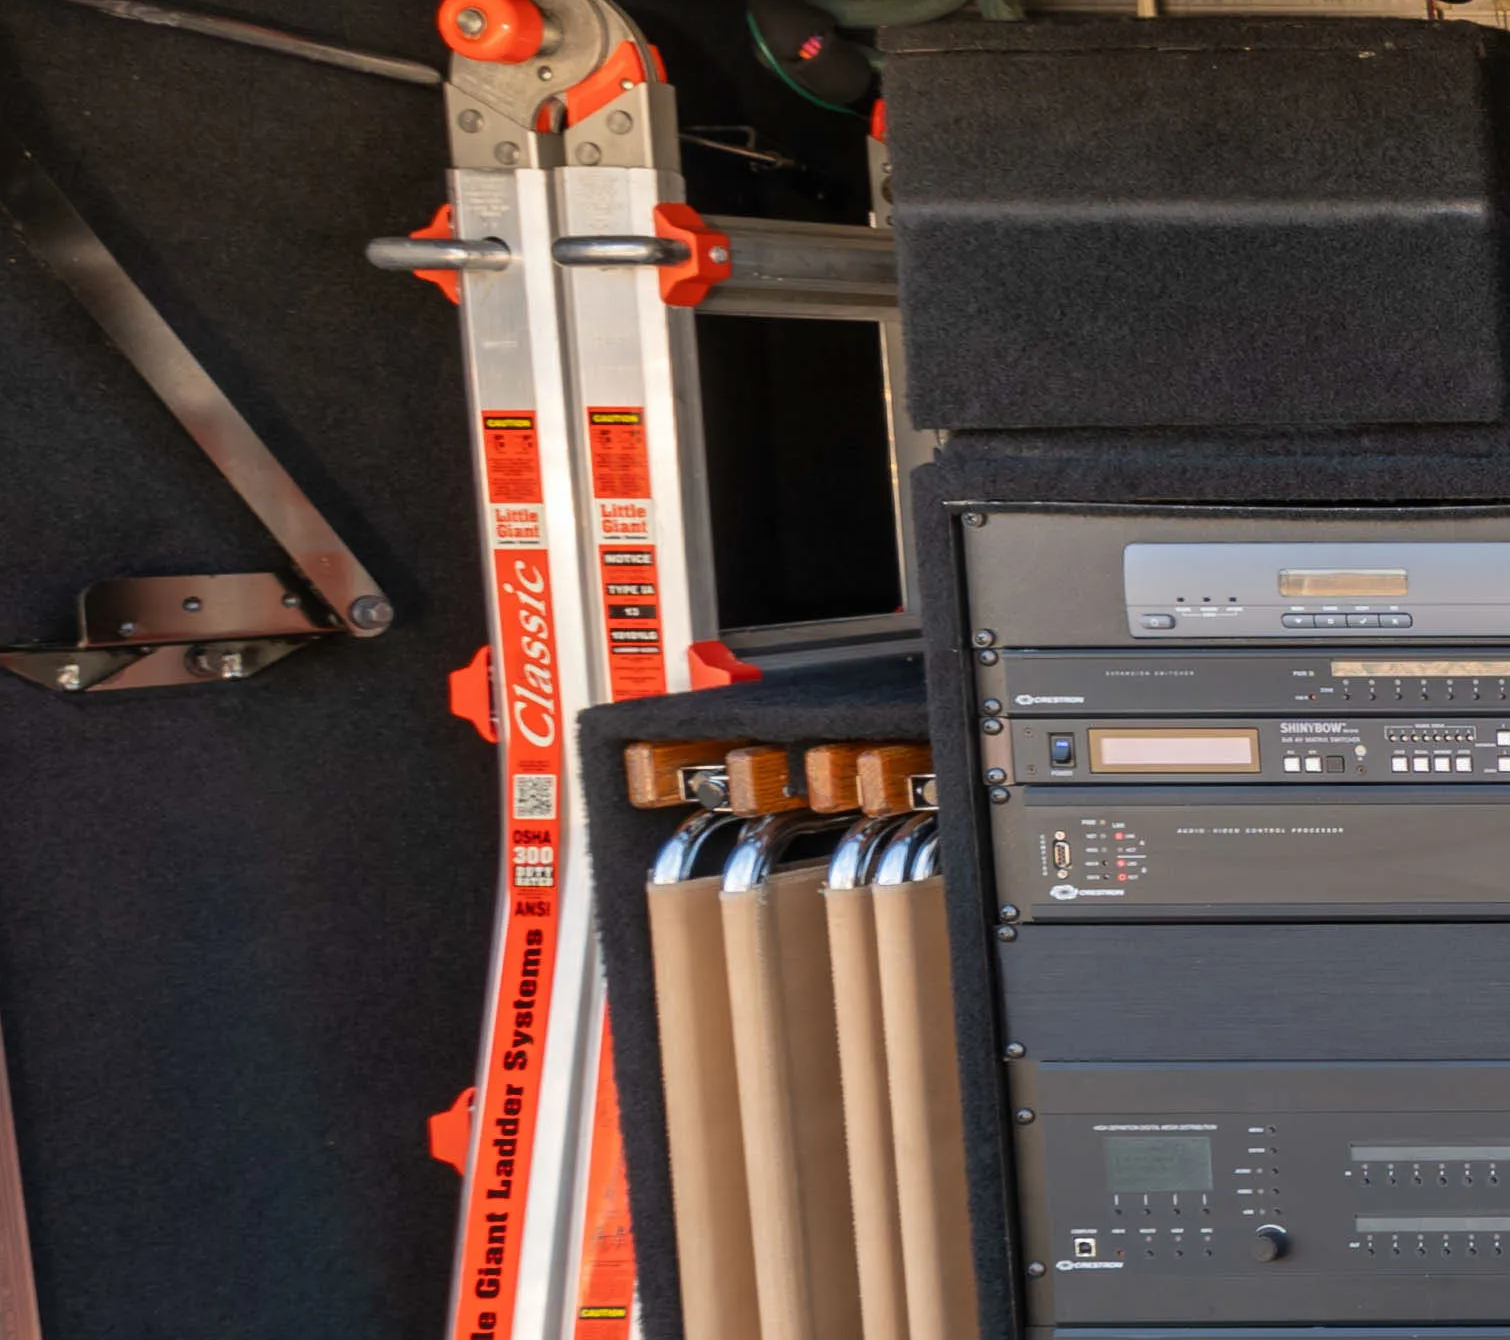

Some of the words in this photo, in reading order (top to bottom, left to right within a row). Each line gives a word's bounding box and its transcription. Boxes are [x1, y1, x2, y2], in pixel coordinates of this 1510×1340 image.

[494, 508, 538, 523] Little
[600, 504, 647, 518] Little
[496, 524, 540, 538] Giant
[602, 519, 648, 534] Giant
[604, 553, 652, 564] NOTICE
[503, 560, 555, 747] Classic
[1279, 721, 1343, 734] SHINYBOW
[512, 830, 552, 844] OSHA
[512, 846, 554, 864] 300
[515, 902, 552, 917] ANSI
[504, 929, 544, 1071] Systems
[486, 1084, 524, 1200] Ladder
[475, 1212, 509, 1300] Giant
